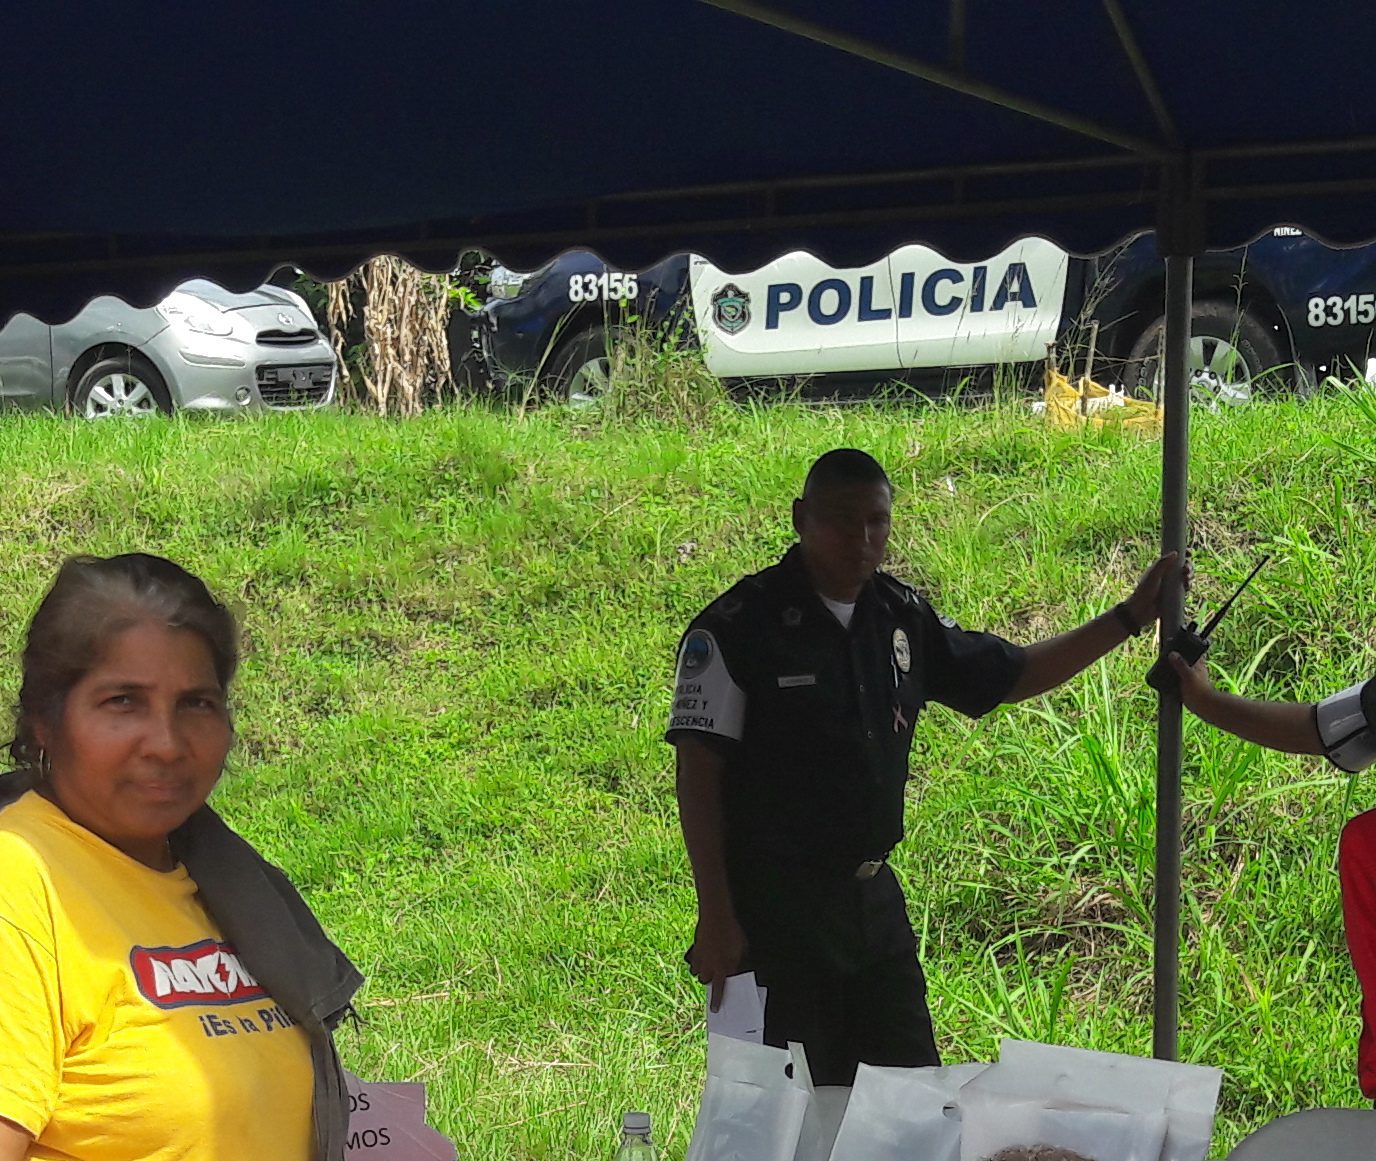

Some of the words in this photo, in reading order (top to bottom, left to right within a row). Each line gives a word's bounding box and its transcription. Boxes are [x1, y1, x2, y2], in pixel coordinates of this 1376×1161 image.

[569, 271, 639, 302] 83156
[765, 262, 1037, 331] POLICIA
[256, 1006, 297, 1032] Pil
[348, 1093, 370, 1112] OS
[345, 1128, 391, 1151] MOS
